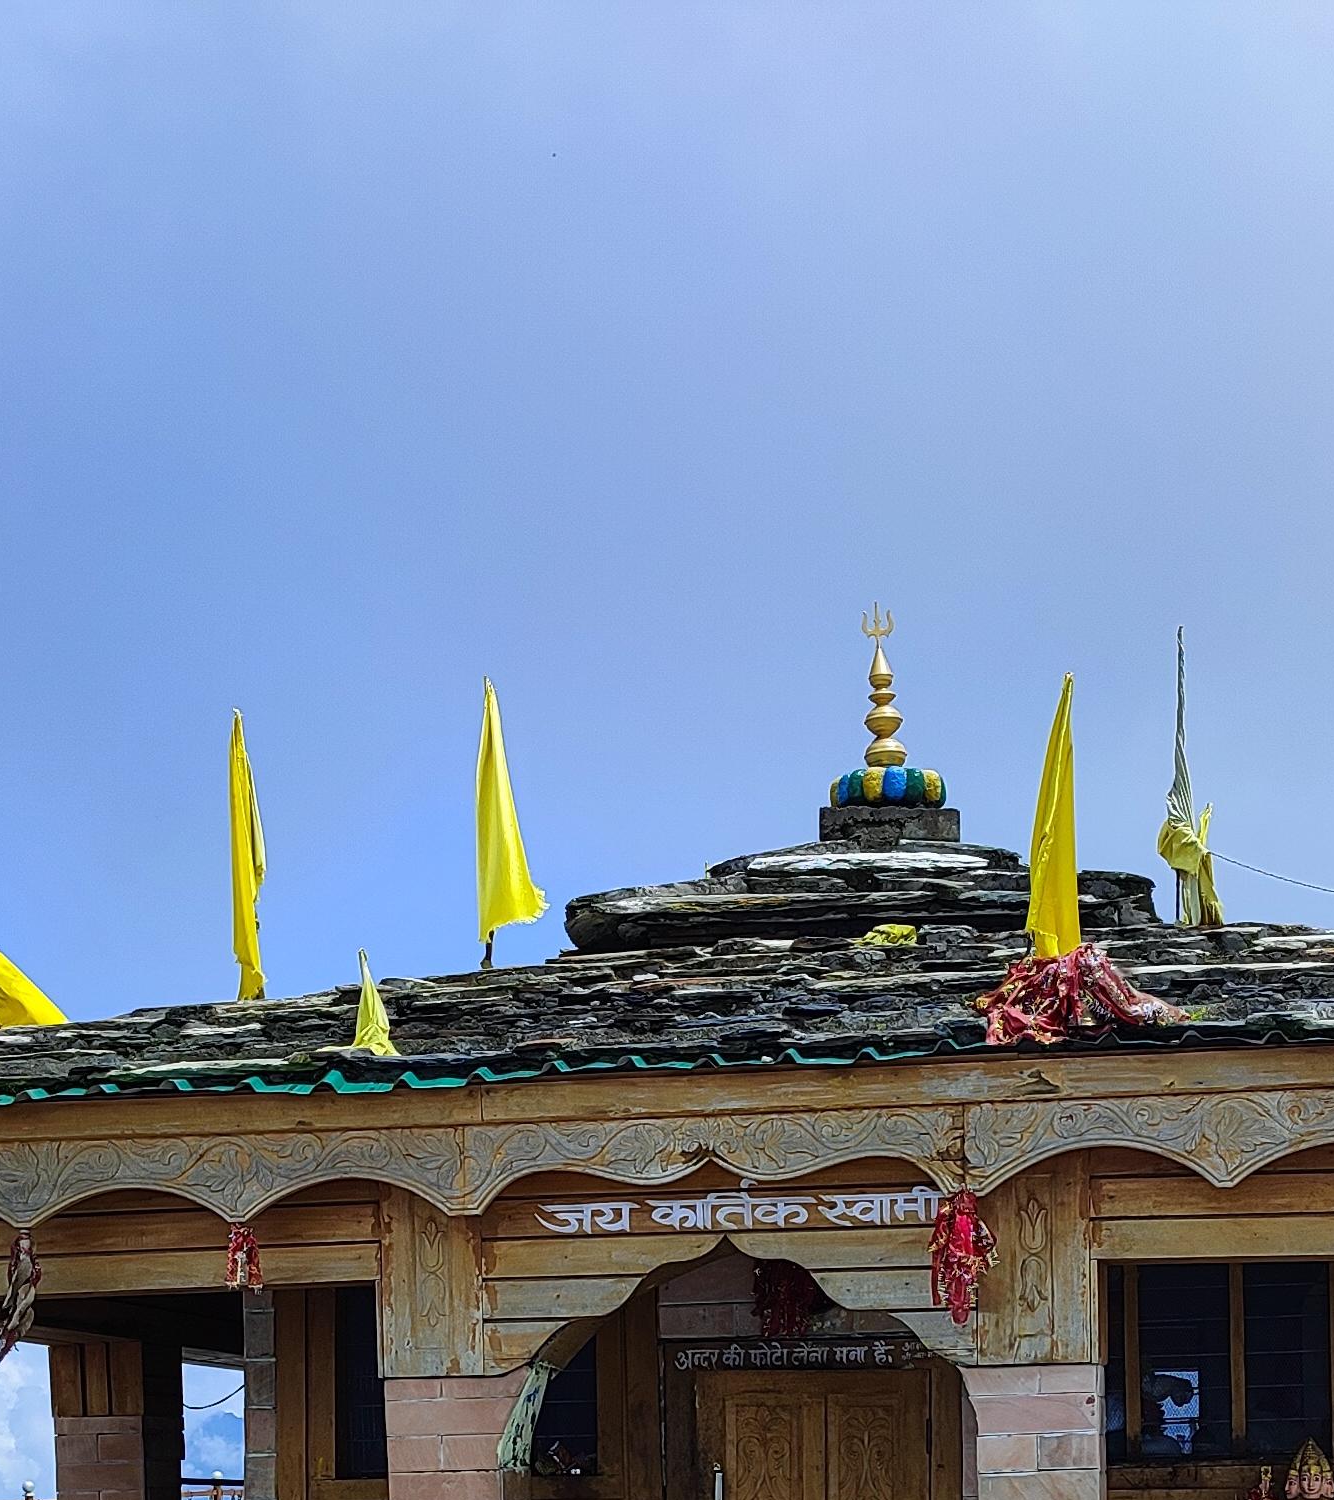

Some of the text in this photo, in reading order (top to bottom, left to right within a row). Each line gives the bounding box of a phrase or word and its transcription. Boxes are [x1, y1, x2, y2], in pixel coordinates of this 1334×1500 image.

[534, 1179, 947, 1234] जय कार्तिक स्वामी
[674, 1349, 720, 1370] अन्दर
[722, 1343, 746, 1367] की
[833, 1345, 869, 1365] मना
